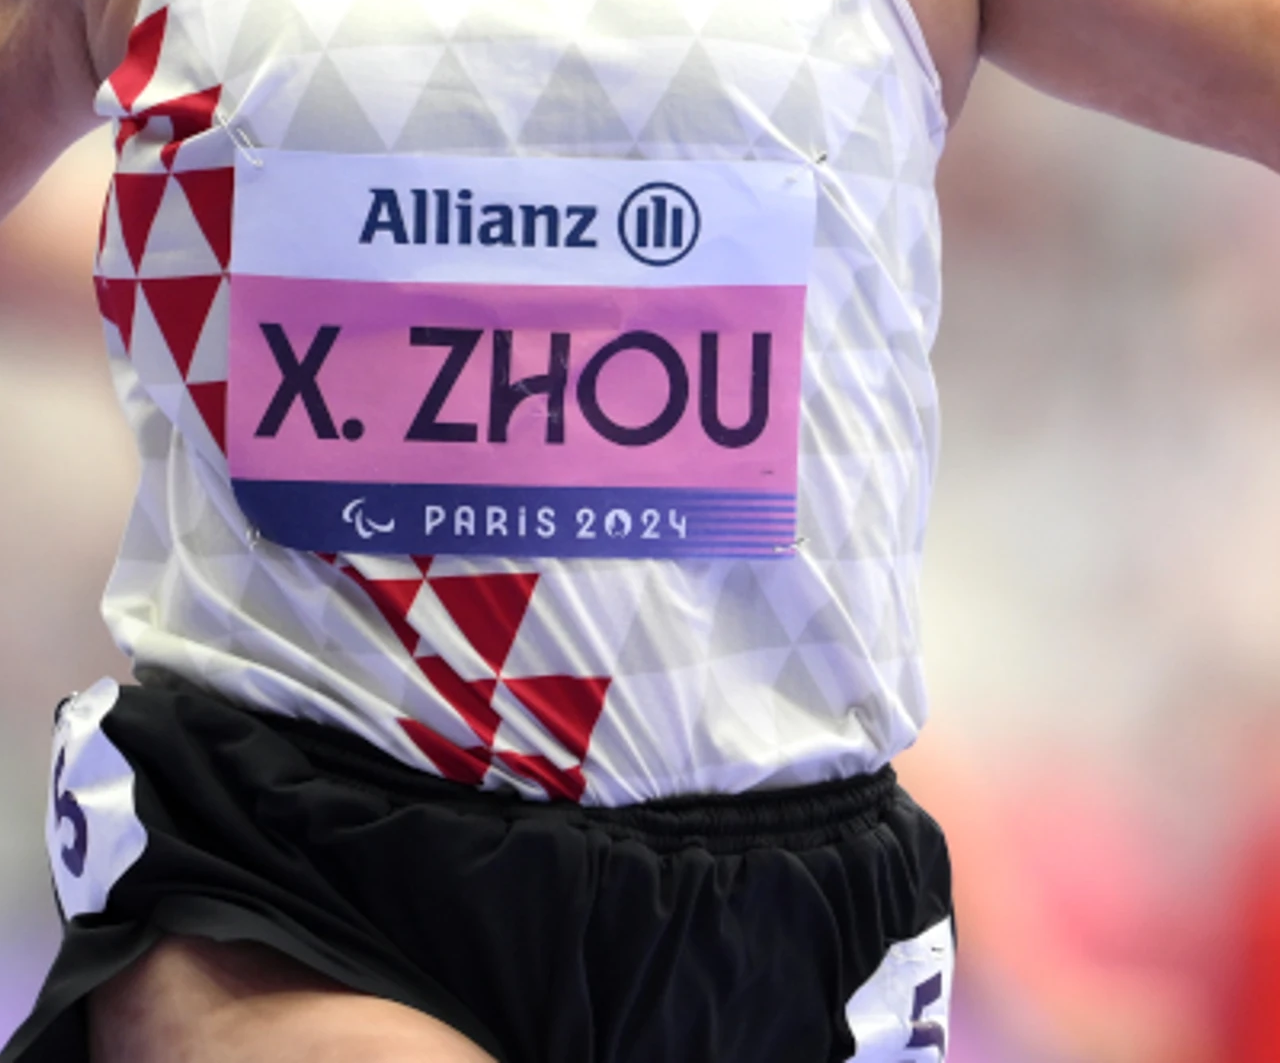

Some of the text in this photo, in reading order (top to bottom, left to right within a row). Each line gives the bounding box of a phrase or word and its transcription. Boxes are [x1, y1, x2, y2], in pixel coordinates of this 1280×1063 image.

[357, 187, 599, 249] Allianz
[253, 321, 773, 449] X. ZHOU
[423, 504, 689, 540] PARIS 2024
